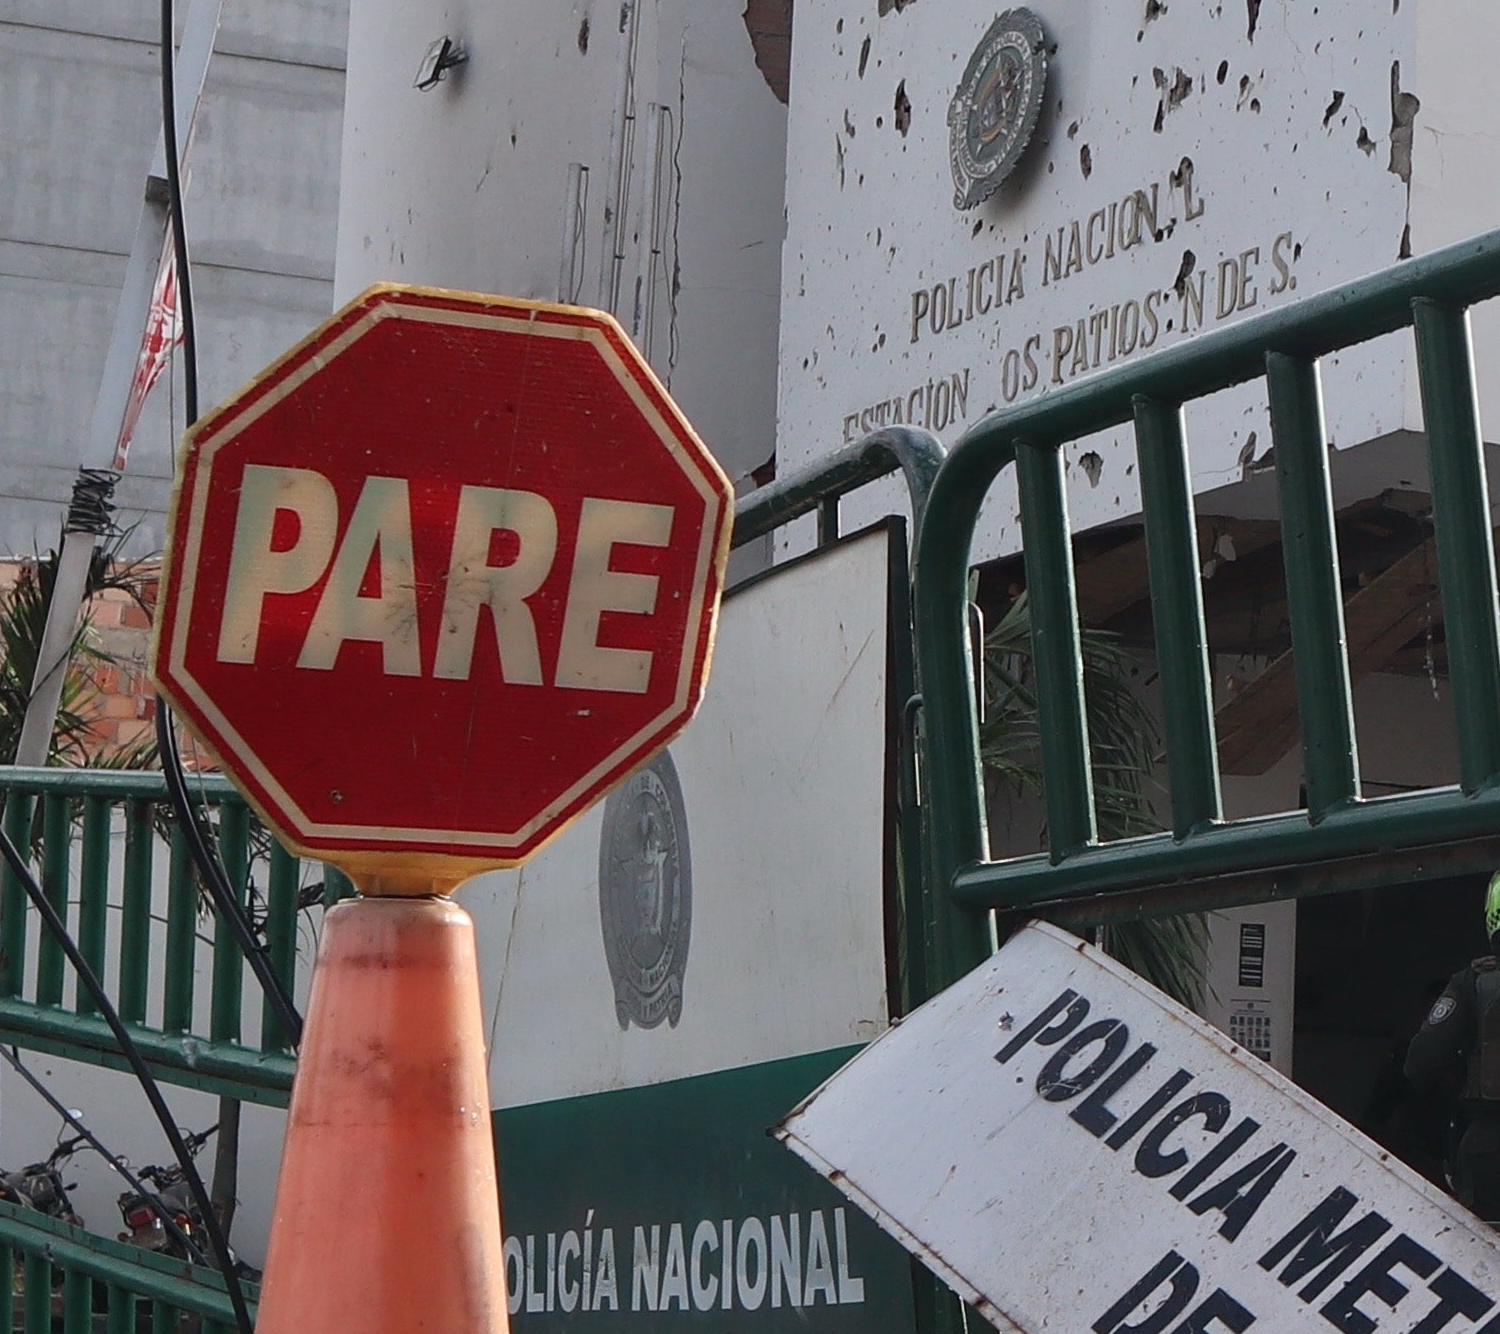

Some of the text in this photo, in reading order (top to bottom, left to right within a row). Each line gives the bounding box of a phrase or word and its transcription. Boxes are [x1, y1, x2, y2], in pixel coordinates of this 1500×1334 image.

[910, 163, 1204, 343] POLICIA NACIONL
[1000, 333, 1041, 403] OS
[1051, 288, 1161, 384] PATIOS
[1216, 247, 1260, 321] DE
[1269, 231, 1297, 296] S.
[216, 463, 675, 694] PARE
[993, 989, 1296, 1239] POLICIA
[501, 1207, 866, 1315] OLICÍA NACIONAL
